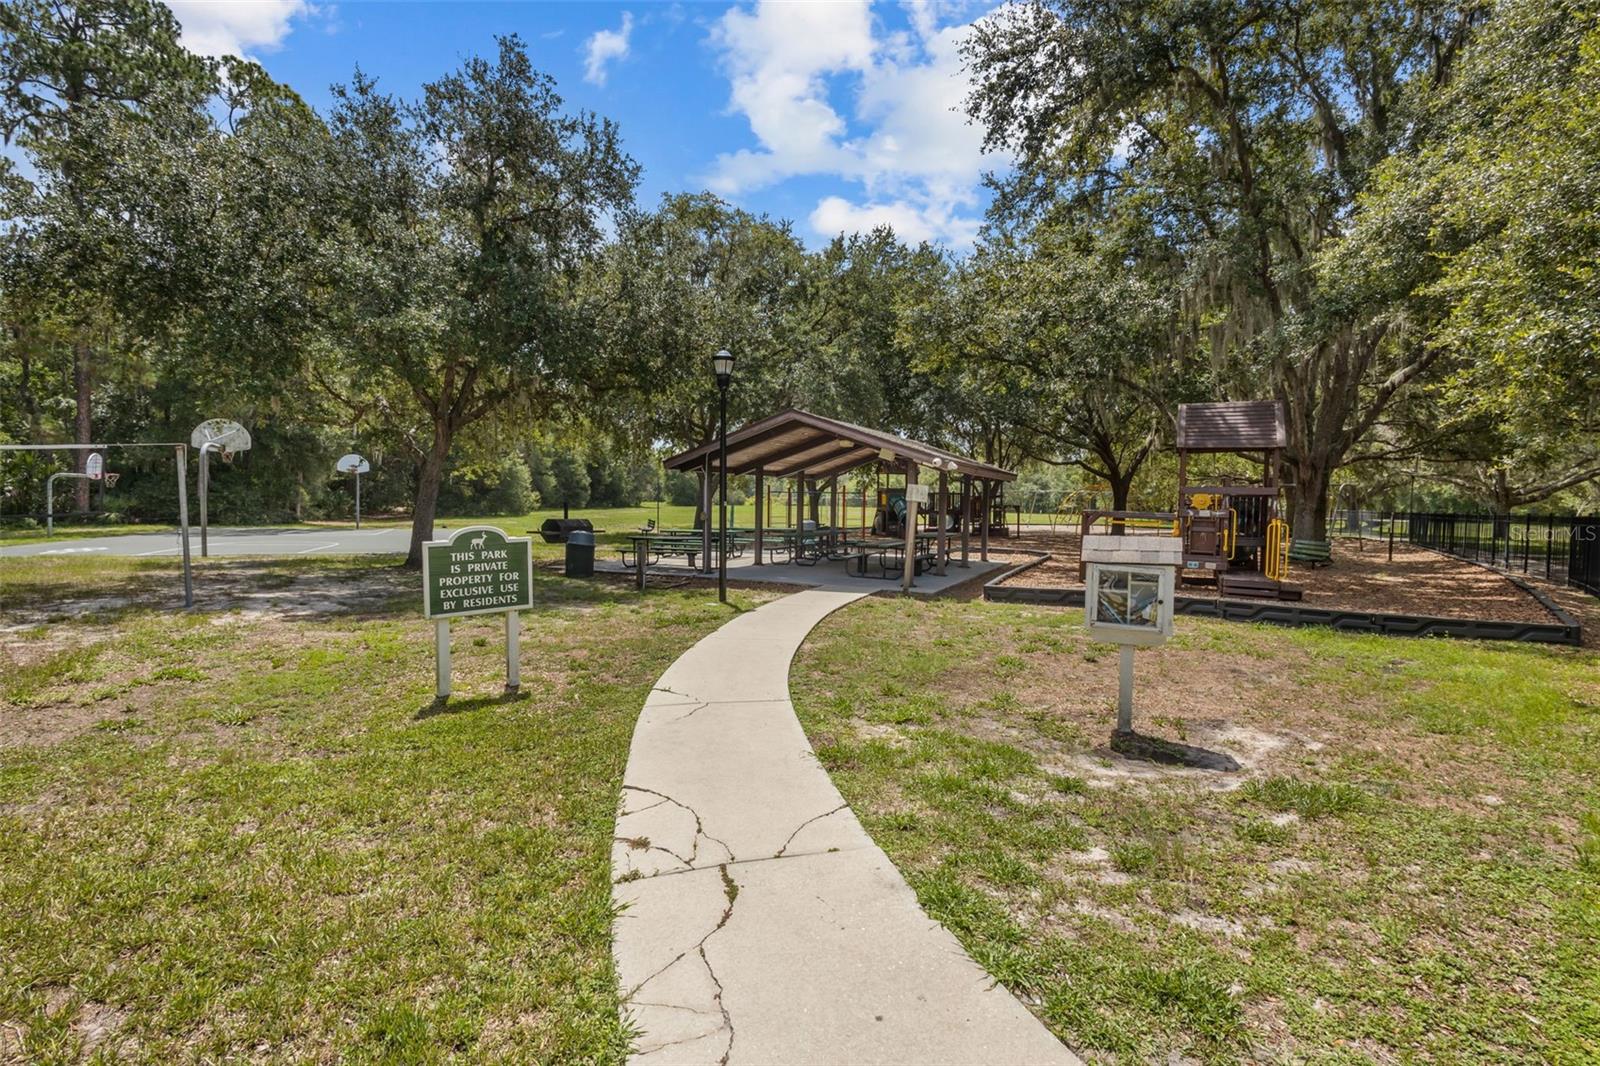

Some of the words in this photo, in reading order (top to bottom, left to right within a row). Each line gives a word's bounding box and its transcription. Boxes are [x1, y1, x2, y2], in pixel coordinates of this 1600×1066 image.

[450, 551, 475, 562] THIS
[481, 550, 508, 560] PARK
[450, 564, 461, 574] IS
[468, 561, 508, 572] PRIVATE
[439, 574, 493, 586] PROPERTY
[500, 572, 520, 582] FOR
[440, 585, 494, 598] EXCLUSIVE
[500, 583, 520, 592] USE
[443, 601, 456, 610] BY
[463, 594, 518, 608] RESIDENTS
